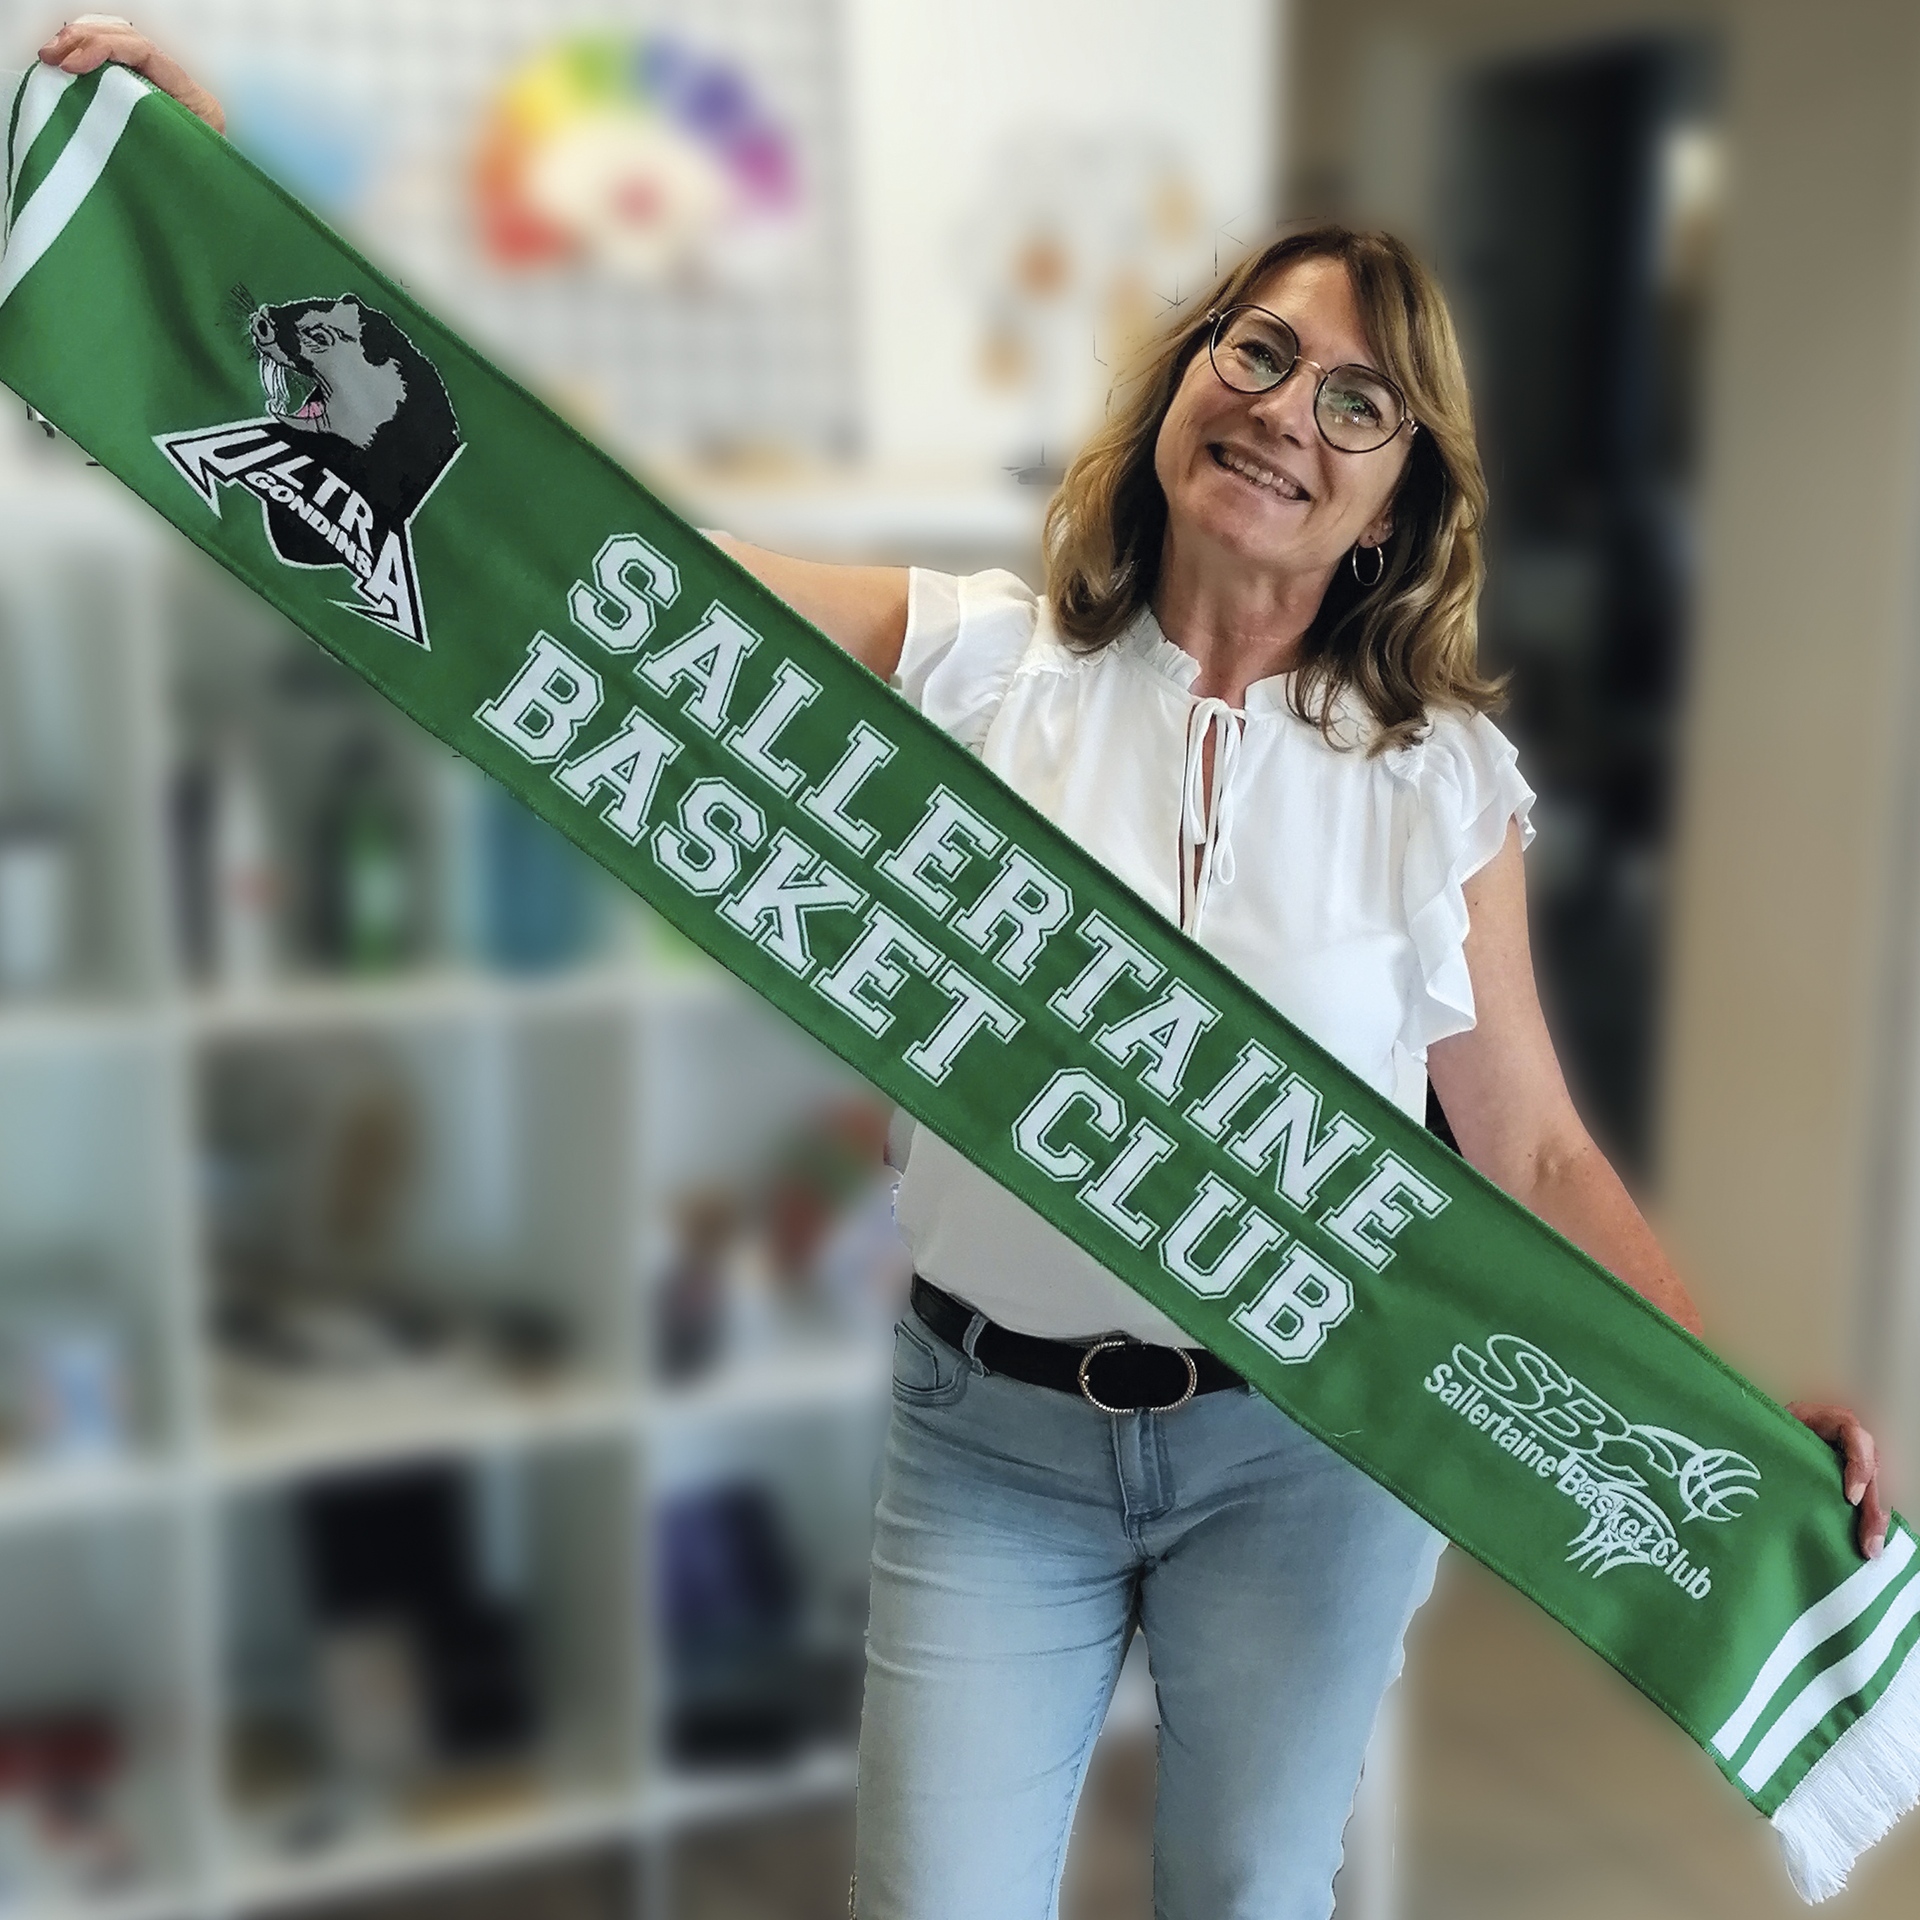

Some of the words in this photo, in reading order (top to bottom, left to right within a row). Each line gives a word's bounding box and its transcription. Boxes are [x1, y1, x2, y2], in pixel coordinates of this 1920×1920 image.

[168, 428, 418, 640] ULTRA
[473, 630, 1026, 1087] BASKET
[1011, 1067, 1354, 1364] CLUB
[567, 533, 1452, 1273] SALLERTAINE
[1424, 1363, 1557, 1477] Sallertaine
[1555, 1463, 1657, 1549] Basket
[1650, 1537, 1711, 1600] Club
